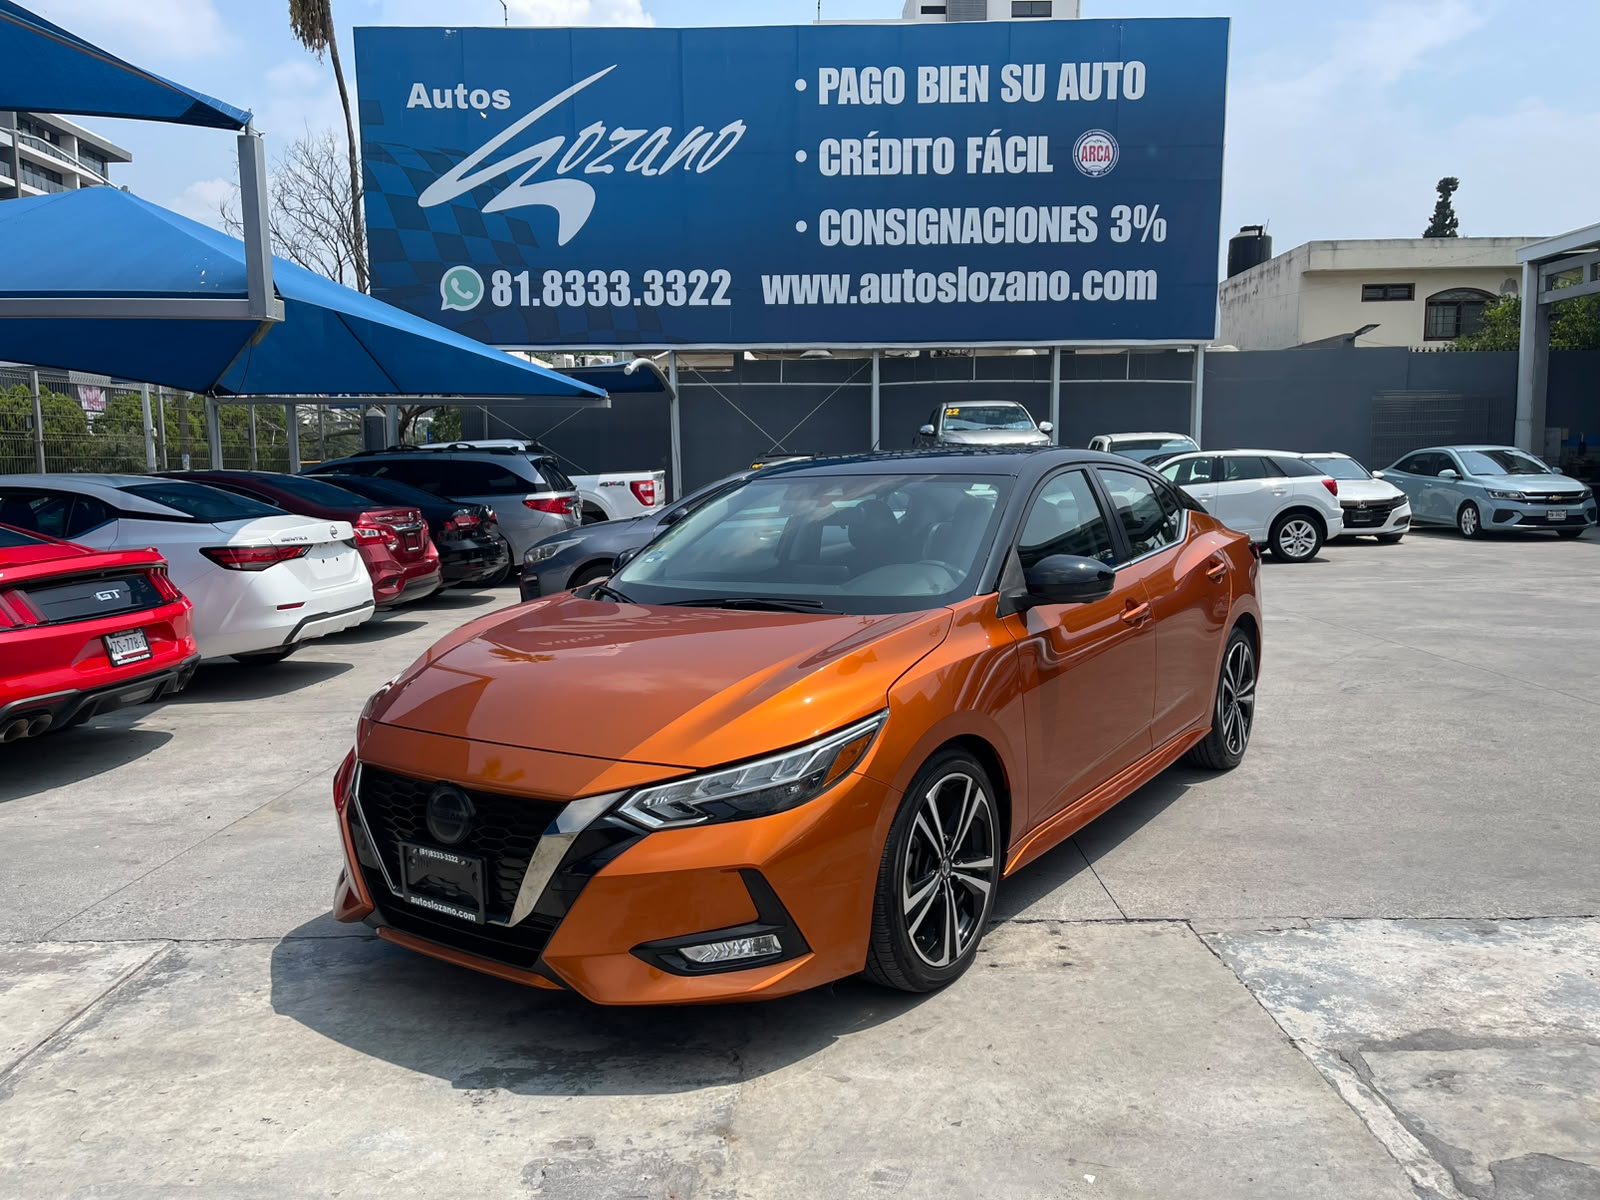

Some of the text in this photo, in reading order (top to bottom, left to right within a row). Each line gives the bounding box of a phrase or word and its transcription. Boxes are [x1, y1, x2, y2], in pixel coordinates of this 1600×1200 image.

[406, 83, 511, 110] Autos
[818, 61, 1146, 104] PAGO BIEN SU AUTO
[417, 64, 747, 247] Lozano
[819, 131, 955, 176] CRÉDITO
[966, 129, 1054, 174] FÁCIL
[1081, 144, 1111, 162] ARCA
[819, 204, 1167, 247] CONSIGNACIONES 3%
[491, 269, 732, 307] 81.8333.3322
[761, 267, 1158, 305] www.autoslozano.com
[95, 589, 120, 601] GT
[410, 896, 476, 922] autoslozano.com
